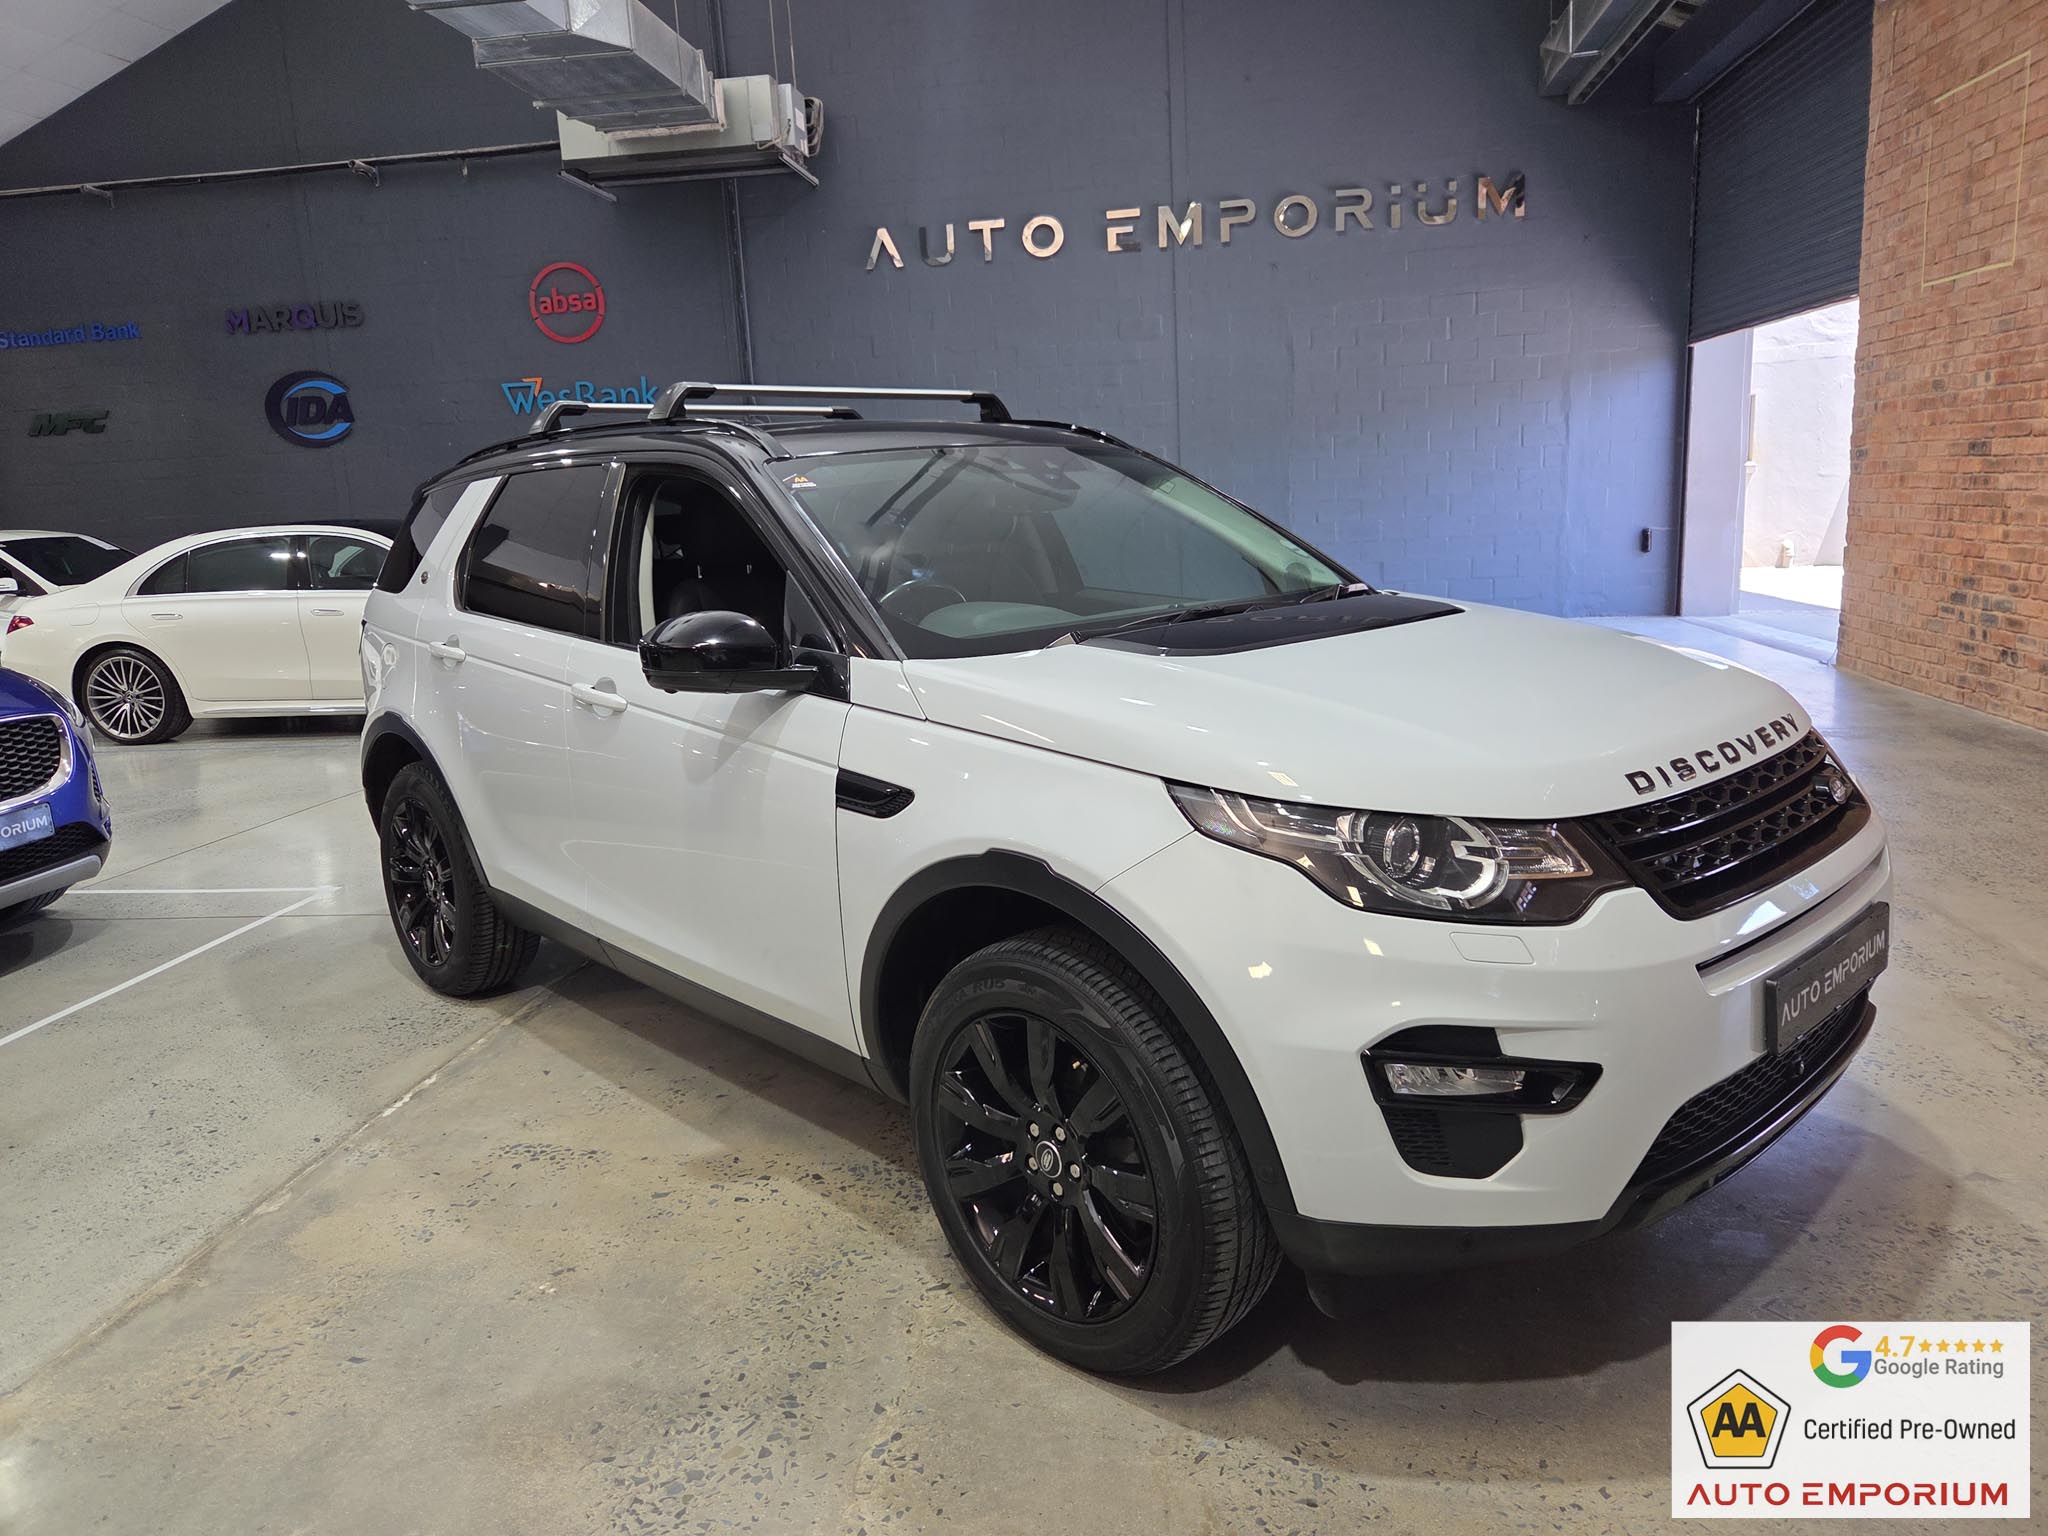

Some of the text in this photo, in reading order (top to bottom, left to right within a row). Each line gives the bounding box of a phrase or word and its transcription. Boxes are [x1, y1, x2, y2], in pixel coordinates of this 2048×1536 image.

[865, 171, 1527, 271] AUTO EMPORIUM
[225, 303, 365, 335] MARQUIS
[539, 287, 598, 315] absa
[0, 320, 142, 348] Standard Bank
[501, 376, 658, 415] WesBank
[1624, 713, 1800, 796] DISCOVERY
[1781, 929, 1886, 1027] AUTO EMPORIUM
